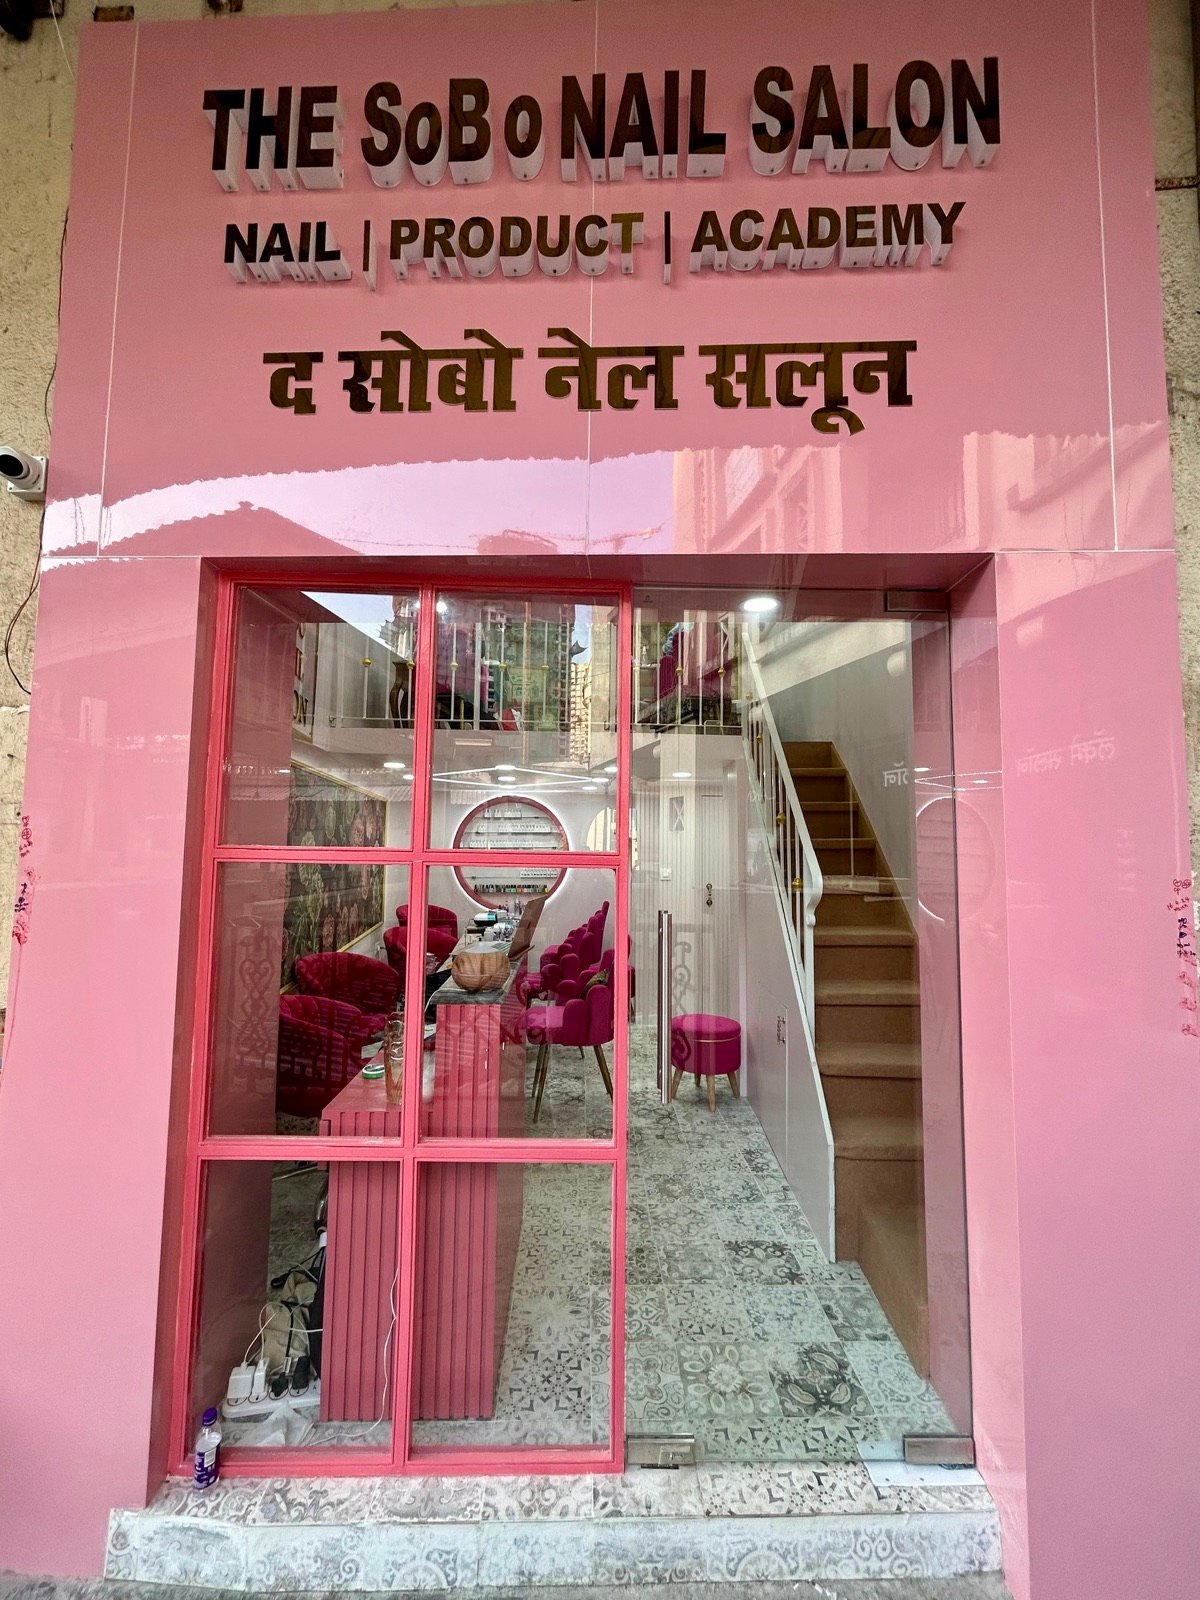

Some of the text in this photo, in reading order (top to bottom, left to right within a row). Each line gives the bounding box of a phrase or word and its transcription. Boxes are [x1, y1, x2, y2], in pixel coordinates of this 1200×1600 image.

[203, 86, 337, 170] THE
[561, 70, 726, 159] NAIL
[752, 57, 1000, 153] SALON
[224, 222, 340, 263] NAIL
[390, 213, 643, 259] PRODUCT
[691, 202, 965, 252] ACADEMY
[263, 328, 917, 434] द सोबो नेल सलून
